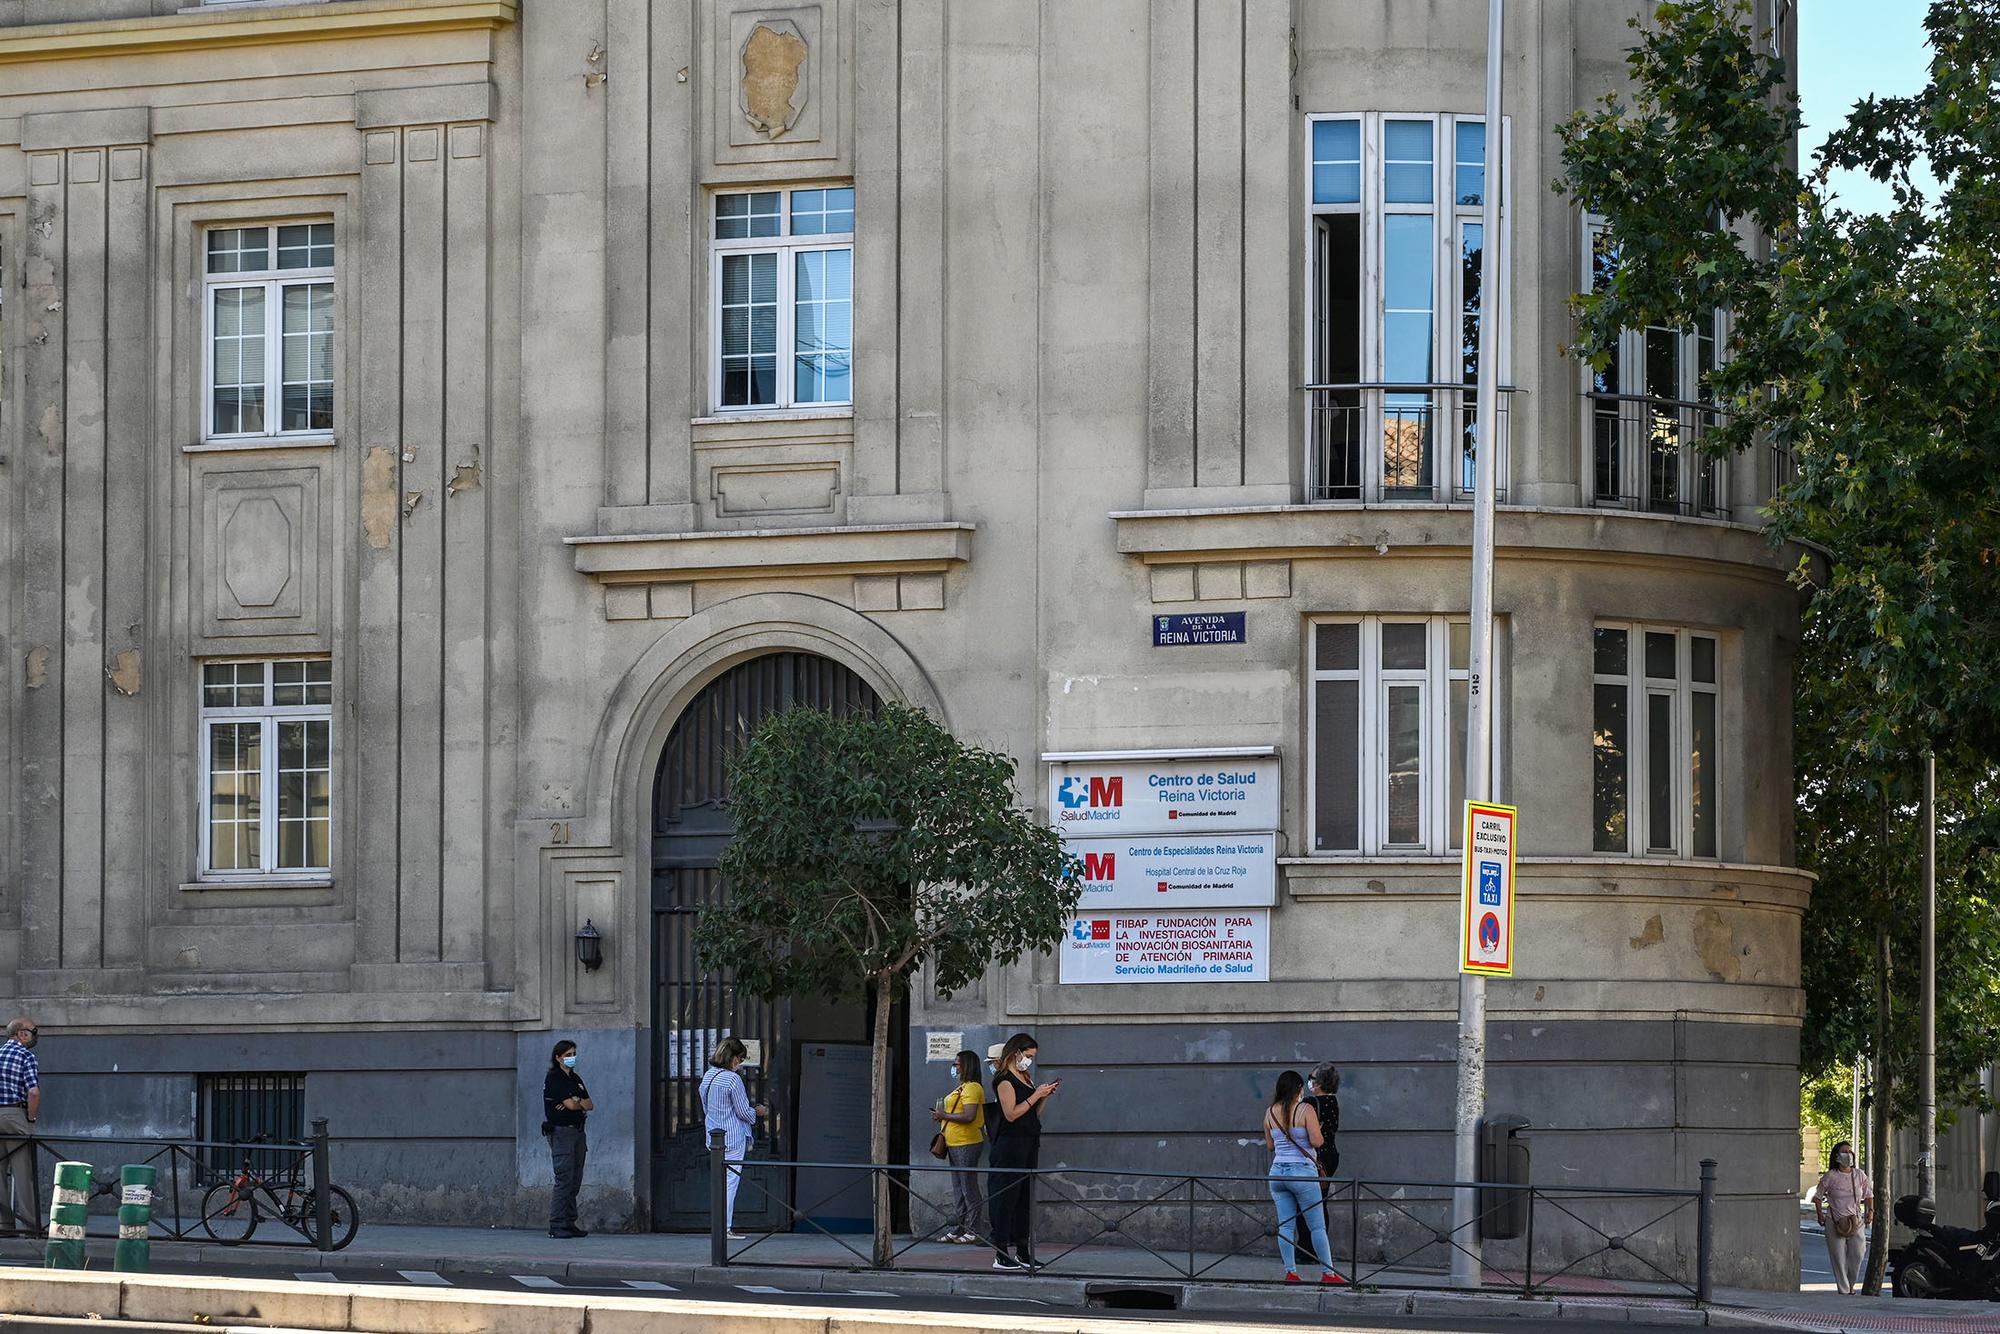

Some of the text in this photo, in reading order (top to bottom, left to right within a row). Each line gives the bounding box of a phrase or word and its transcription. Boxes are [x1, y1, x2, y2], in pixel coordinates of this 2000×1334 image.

[1181, 616, 1225, 625] AVENIDA
[1160, 630, 1237, 644] REINA VICTORIA
[1148, 772, 1256, 787] Centro de Salud
[1159, 789, 1245, 802] Reina Victoria
[1061, 810, 1120, 821] SaludMadrid
[1482, 821, 1501, 831] CARRIL
[550, 821, 569, 844] 21
[1476, 832, 1507, 843] EXCLUSIVO
[1129, 845, 1264, 858] Centro de Especialidades Reina Victoria
[1145, 866, 1247, 878] Hospital Central de la Cruz Roja
[1483, 893, 1498, 903] TAXI
[1116, 917, 1252, 929] FIIBAP FUNDACIÓN PARA
[1116, 929, 1233, 940] LA INVESTIGACIÓN E
[1115, 940, 1252, 951] INNOVACIÓN BIOSANITARIA
[1116, 951, 1252, 962] DE ATENCIÓN PRIMARIA
[1115, 964, 1253, 975] Servicio Madrileño de Salud
